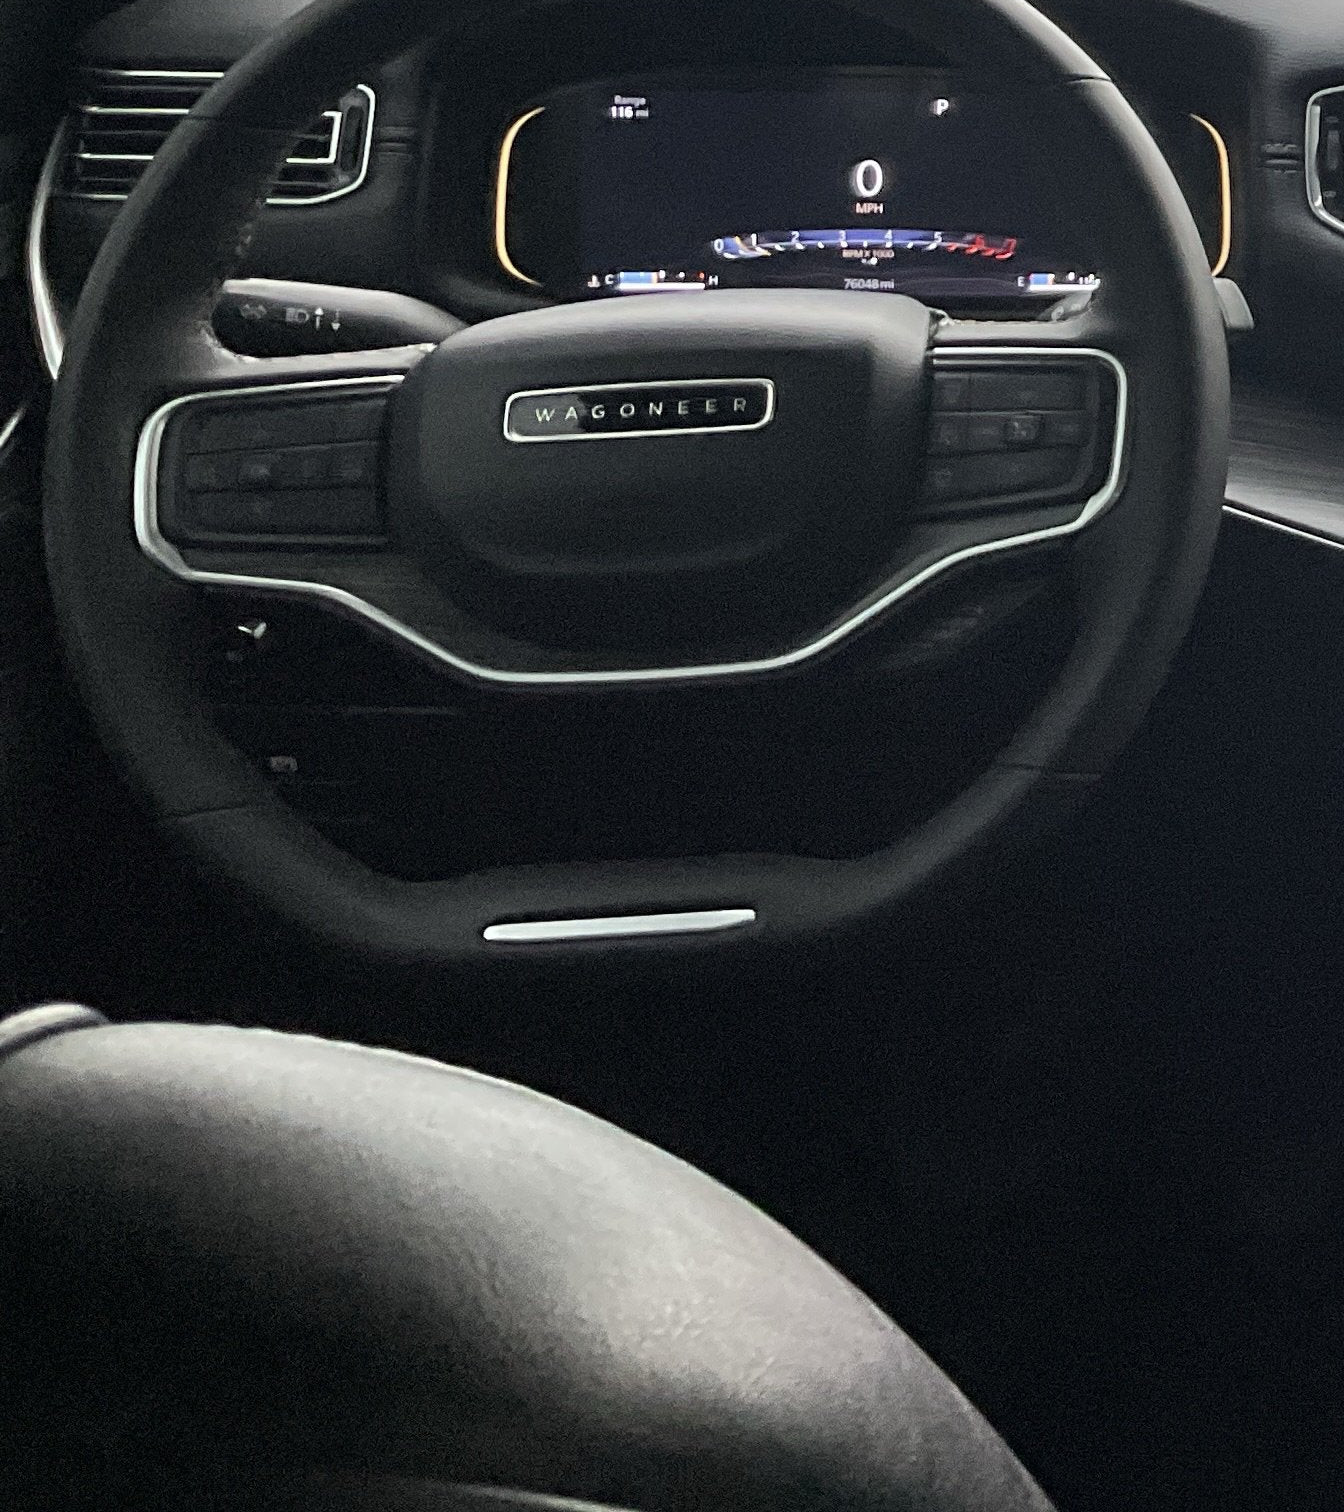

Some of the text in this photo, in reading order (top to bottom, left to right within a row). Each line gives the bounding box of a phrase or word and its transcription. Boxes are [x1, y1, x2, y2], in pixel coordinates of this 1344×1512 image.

[610, 105, 634, 118] 116
[935, 98, 950, 116] P
[856, 159, 883, 198] 0
[855, 202, 884, 214] MPH
[791, 230, 800, 243] 2
[884, 230, 893, 242] 4
[933, 230, 943, 242] 5
[708, 275, 719, 286] H
[844, 278, 895, 290] 76048 mi
[1017, 275, 1026, 287] E
[535, 397, 748, 422] WAGONEER
